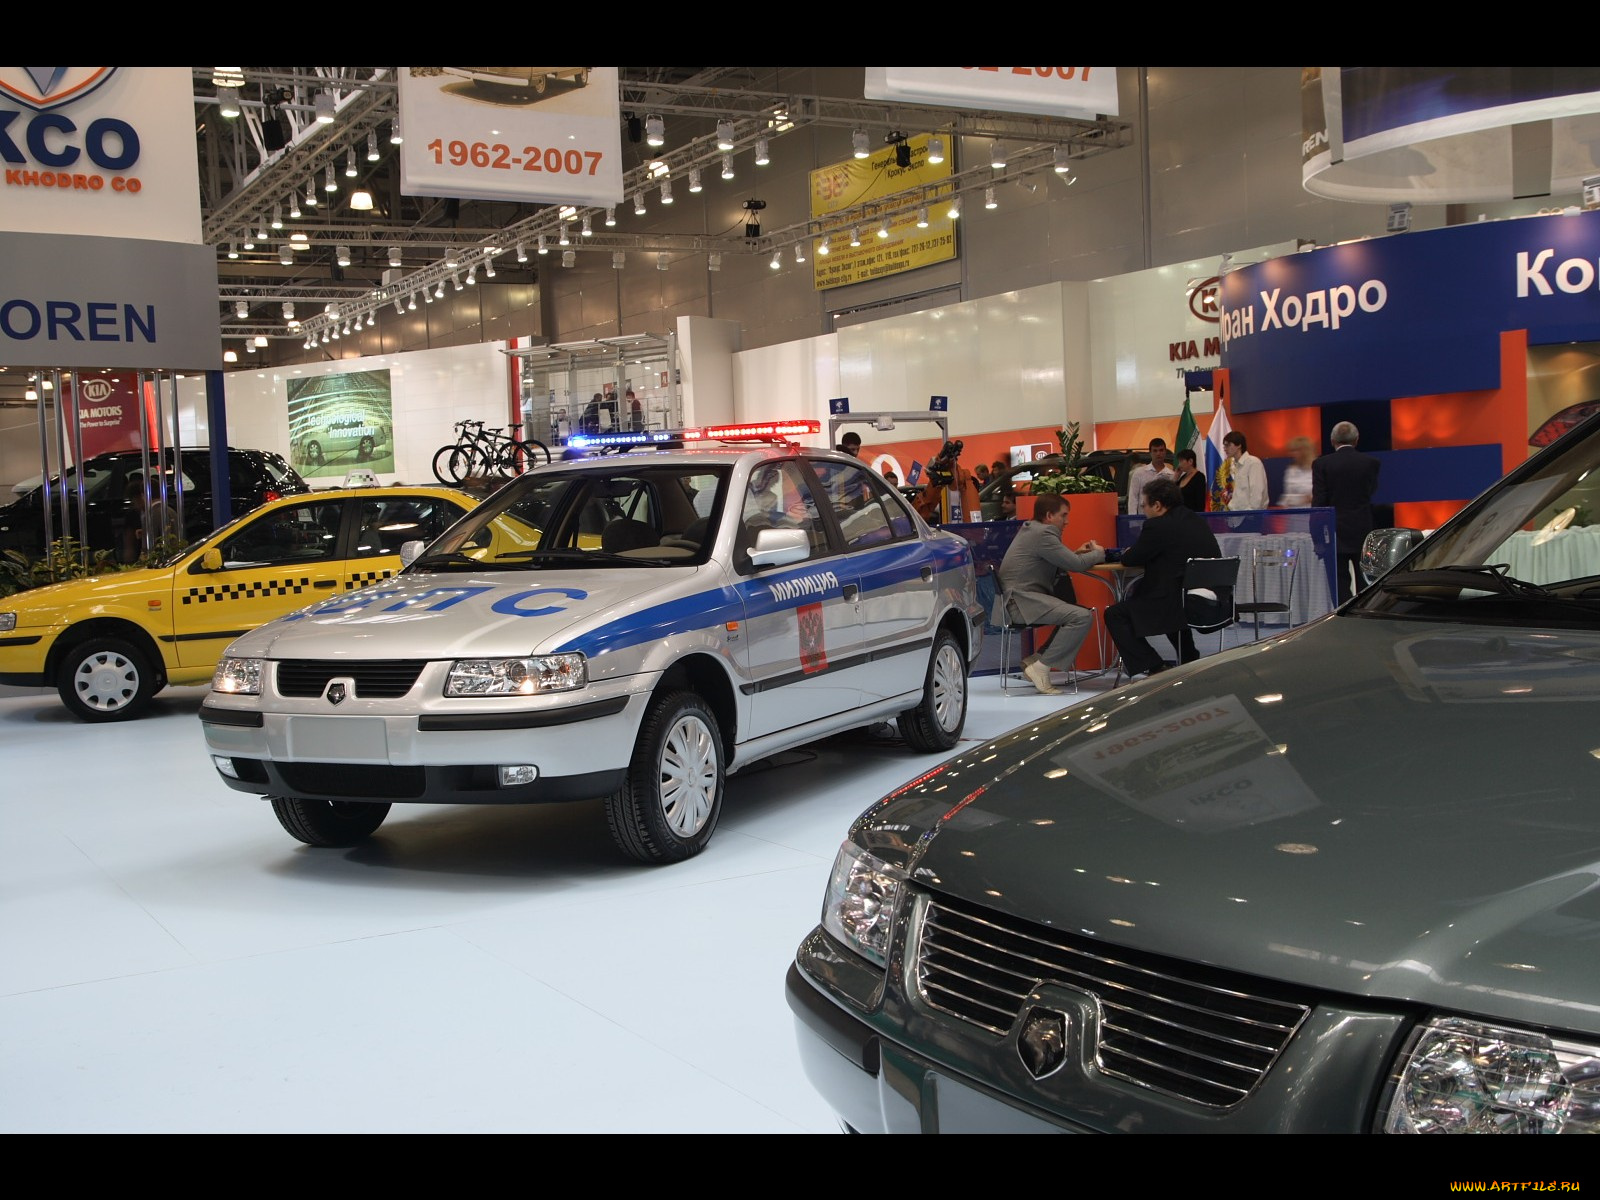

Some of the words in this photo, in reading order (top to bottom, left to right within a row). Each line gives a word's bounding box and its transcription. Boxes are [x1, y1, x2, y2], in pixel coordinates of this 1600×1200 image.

[427, 138, 602, 175] 1962-2007
[6, 169, 104, 190] KHODRO
[111, 176, 142, 193] CO
[1260, 279, 1388, 332] Ходро
[1517, 248, 1600, 298] Ко
[0, 299, 156, 344] OREN
[1169, 338, 1199, 362] KIA
[88, 383, 107, 398] KIA
[79, 408, 90, 419] IA
[91, 405, 122, 418] MOTORS
[307, 410, 365, 426] Technological
[329, 424, 374, 439] Innovation
[768, 571, 839, 602] МИЛИЦИЯ
